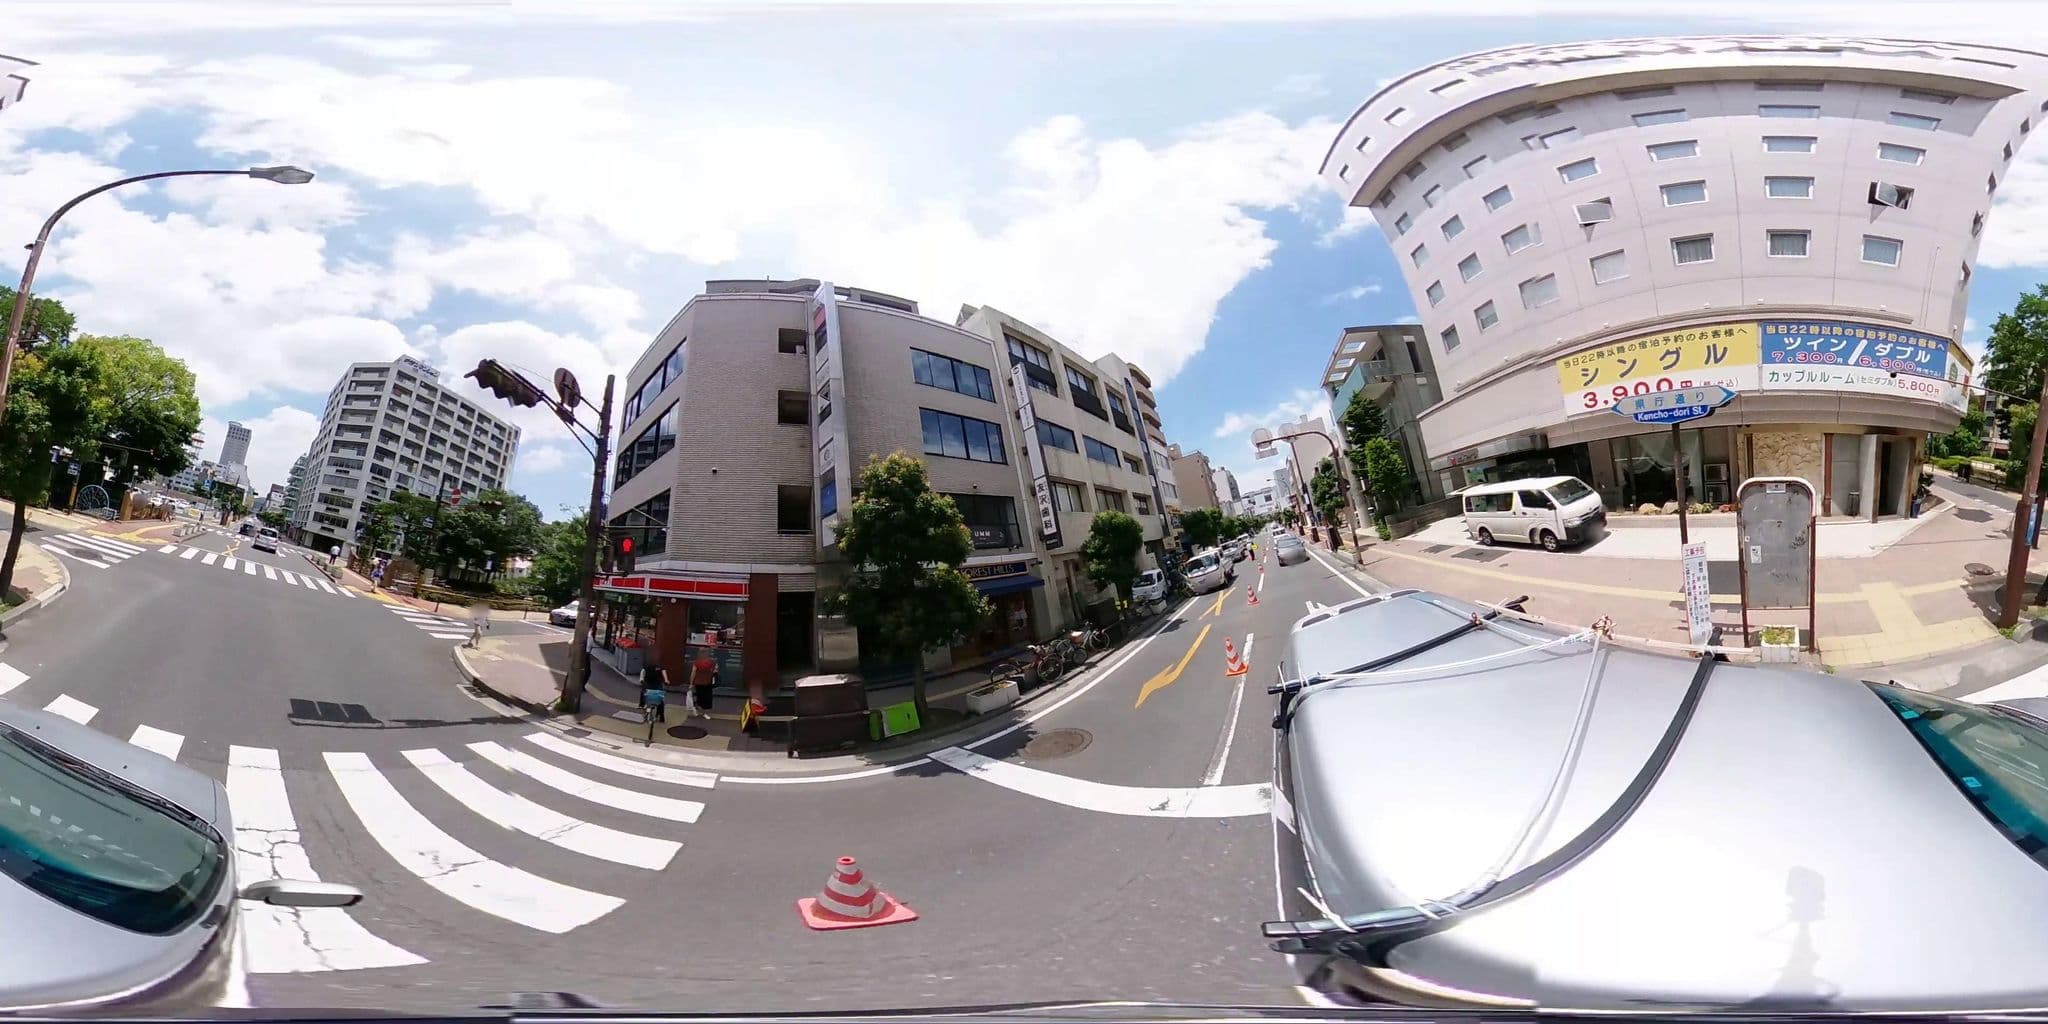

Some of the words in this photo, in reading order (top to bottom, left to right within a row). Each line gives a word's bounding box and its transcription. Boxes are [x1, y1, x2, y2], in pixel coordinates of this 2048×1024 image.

[1580, 343, 1728, 387] シングル
[1768, 369, 1855, 385] カップルルーム
[1634, 391, 1705, 410] 県庁通り
[1637, 406, 1690, 421] Kencho-dori
